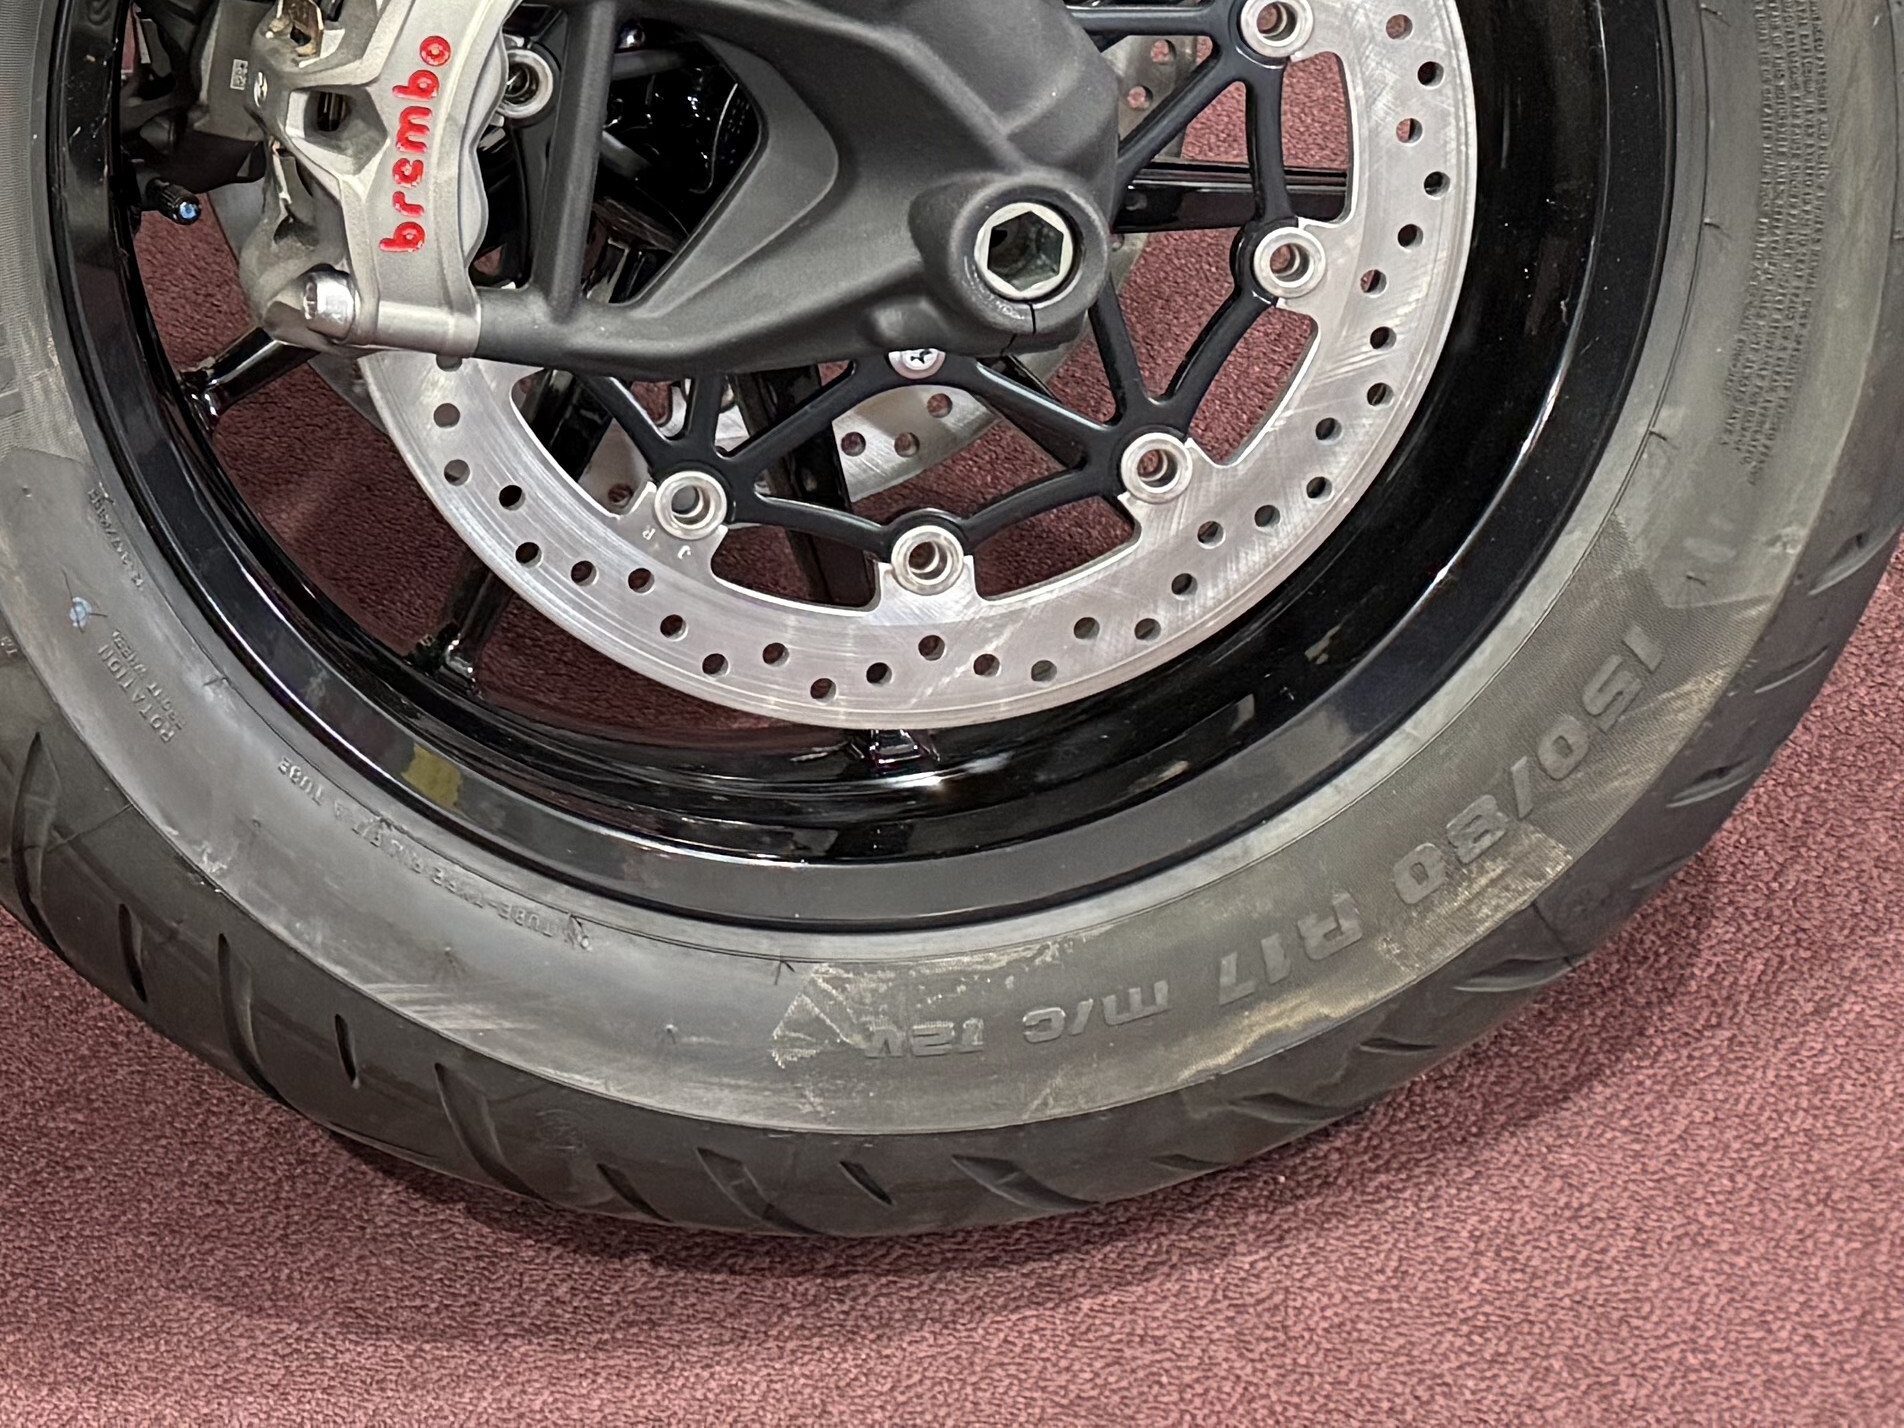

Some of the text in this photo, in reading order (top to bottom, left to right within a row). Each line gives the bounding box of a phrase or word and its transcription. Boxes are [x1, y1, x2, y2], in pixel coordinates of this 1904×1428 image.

[379, 34, 454, 254] brembo
[97, 642, 176, 744] ROTATION
[1217, 889, 1366, 1009] R17
